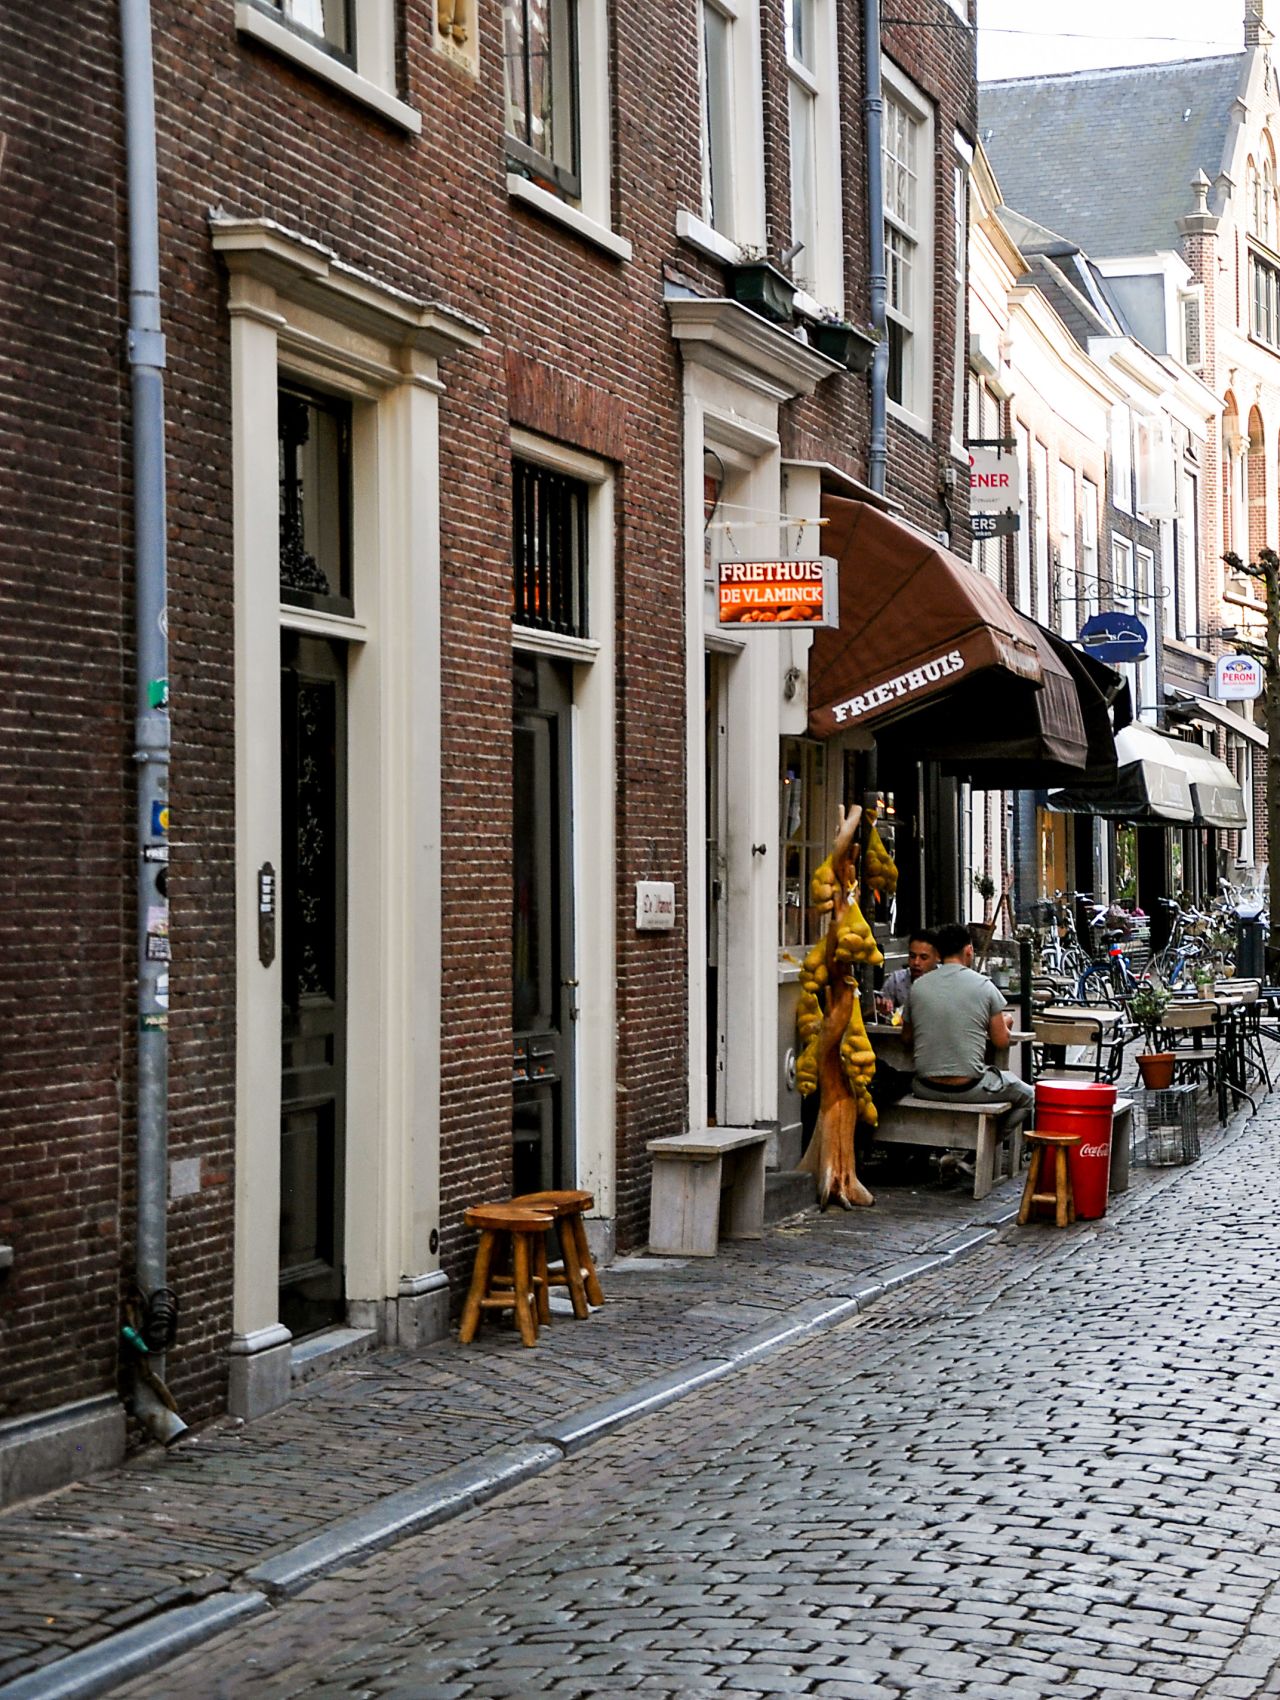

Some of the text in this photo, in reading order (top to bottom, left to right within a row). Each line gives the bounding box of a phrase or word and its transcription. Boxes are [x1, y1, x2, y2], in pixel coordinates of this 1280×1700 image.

[720, 562, 823, 582] FRIETHUIS
[720, 586, 823, 604] DE VLAMINCK
[831, 649, 965, 723] FRIETHUIS
[1222, 672, 1256, 681] PERONI
